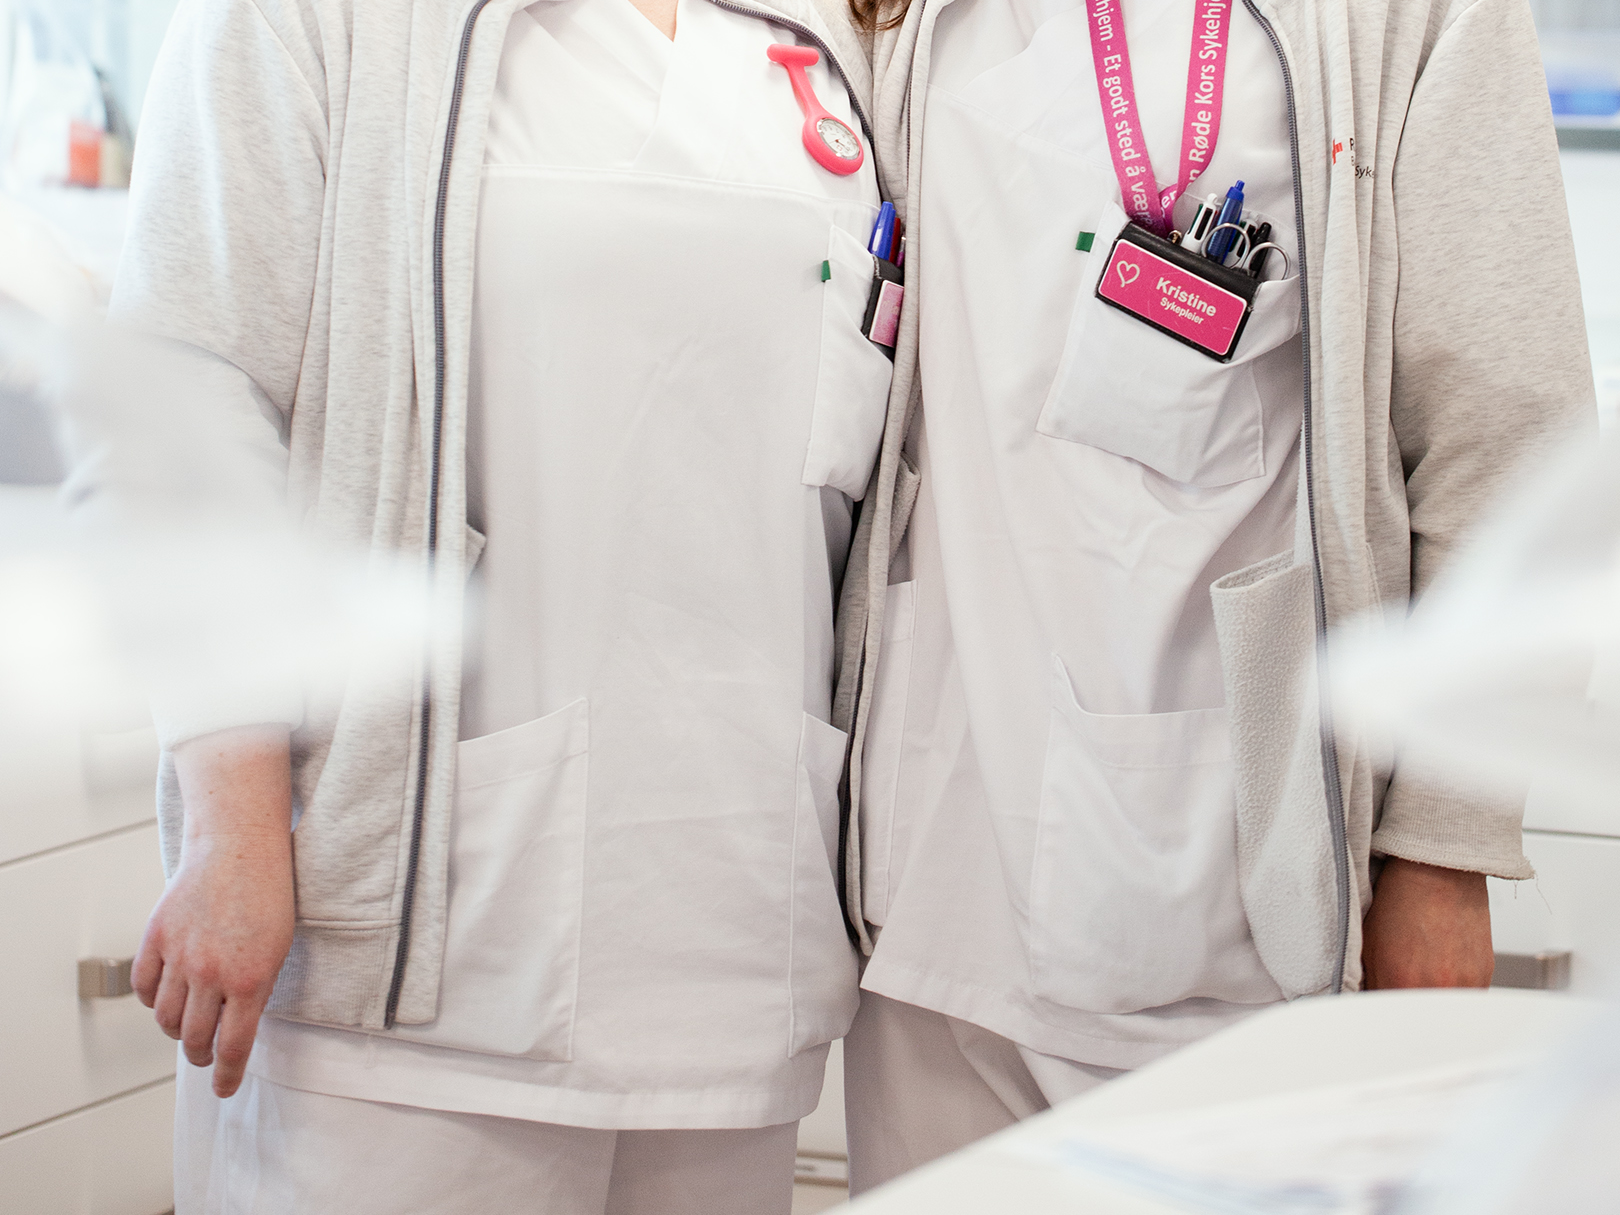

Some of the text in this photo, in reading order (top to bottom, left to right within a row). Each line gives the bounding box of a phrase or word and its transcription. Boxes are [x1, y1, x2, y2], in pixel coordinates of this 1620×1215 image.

[1103, 53, 1122, 73] Et
[1102, 75, 1130, 118] godt
[1194, 63, 1216, 105] Kors
[1115, 120, 1141, 161] sted
[1188, 110, 1213, 163] Røde
[1125, 165, 1146, 177] å
[1155, 277, 1217, 317] Kristine
[1160, 297, 1204, 325] Sykepleier
